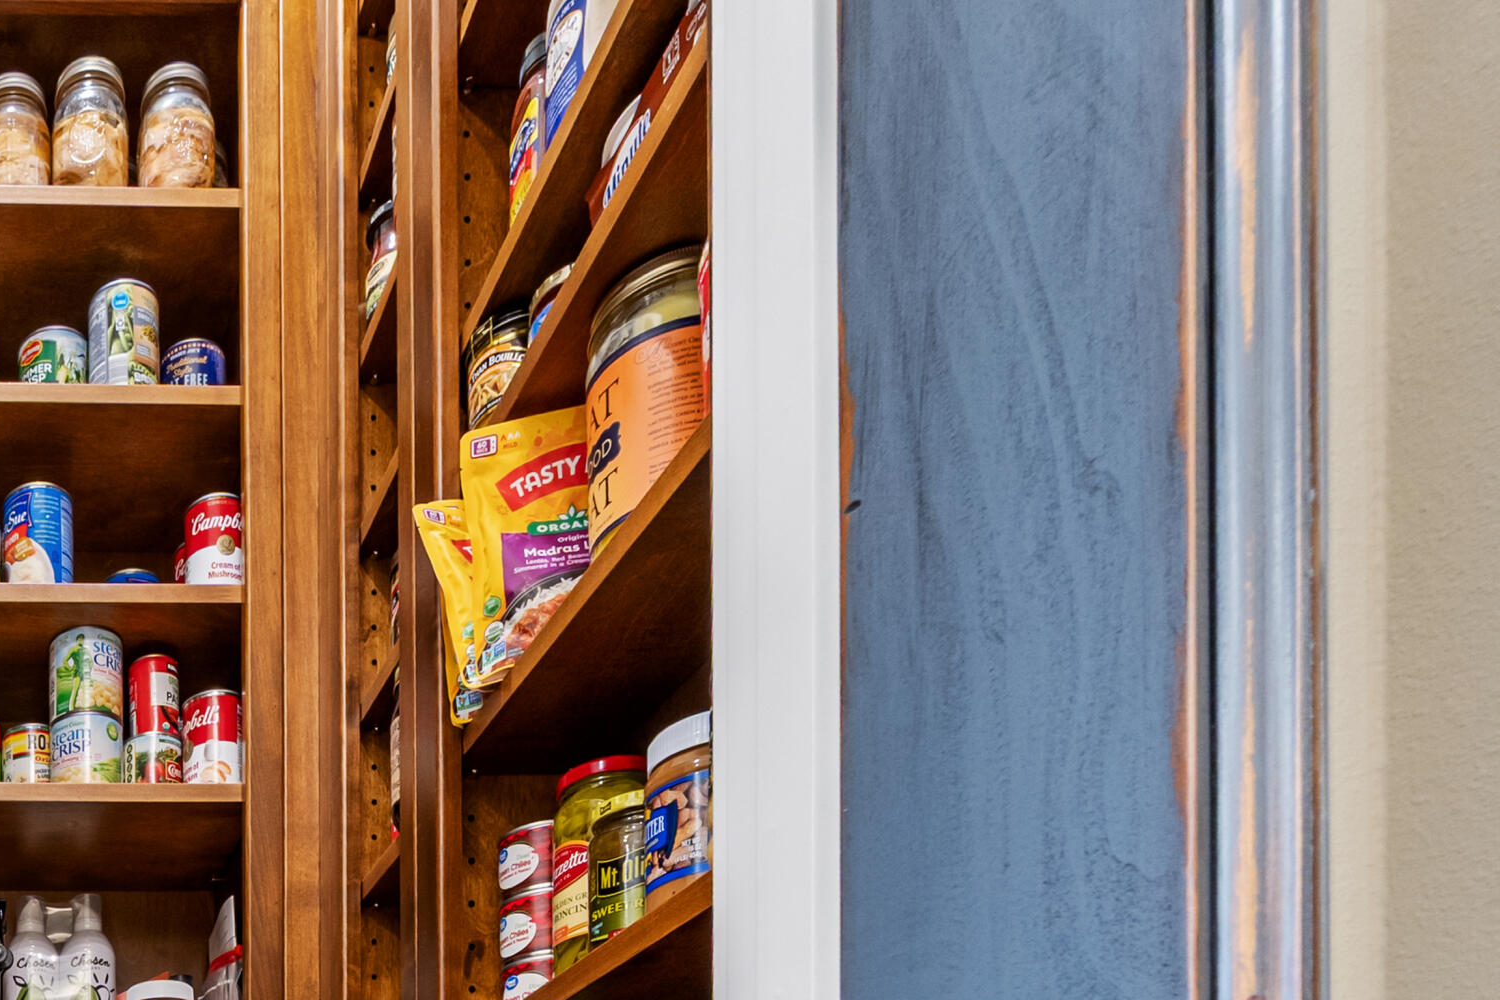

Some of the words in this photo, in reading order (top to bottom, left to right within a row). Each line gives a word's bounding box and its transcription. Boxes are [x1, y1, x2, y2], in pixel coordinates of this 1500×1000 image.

[509, 454, 581, 498] TASTY
[5, 511, 27, 533] Sue
[524, 544, 581, 558] Madras
[601, 864, 620, 890] Mt.
